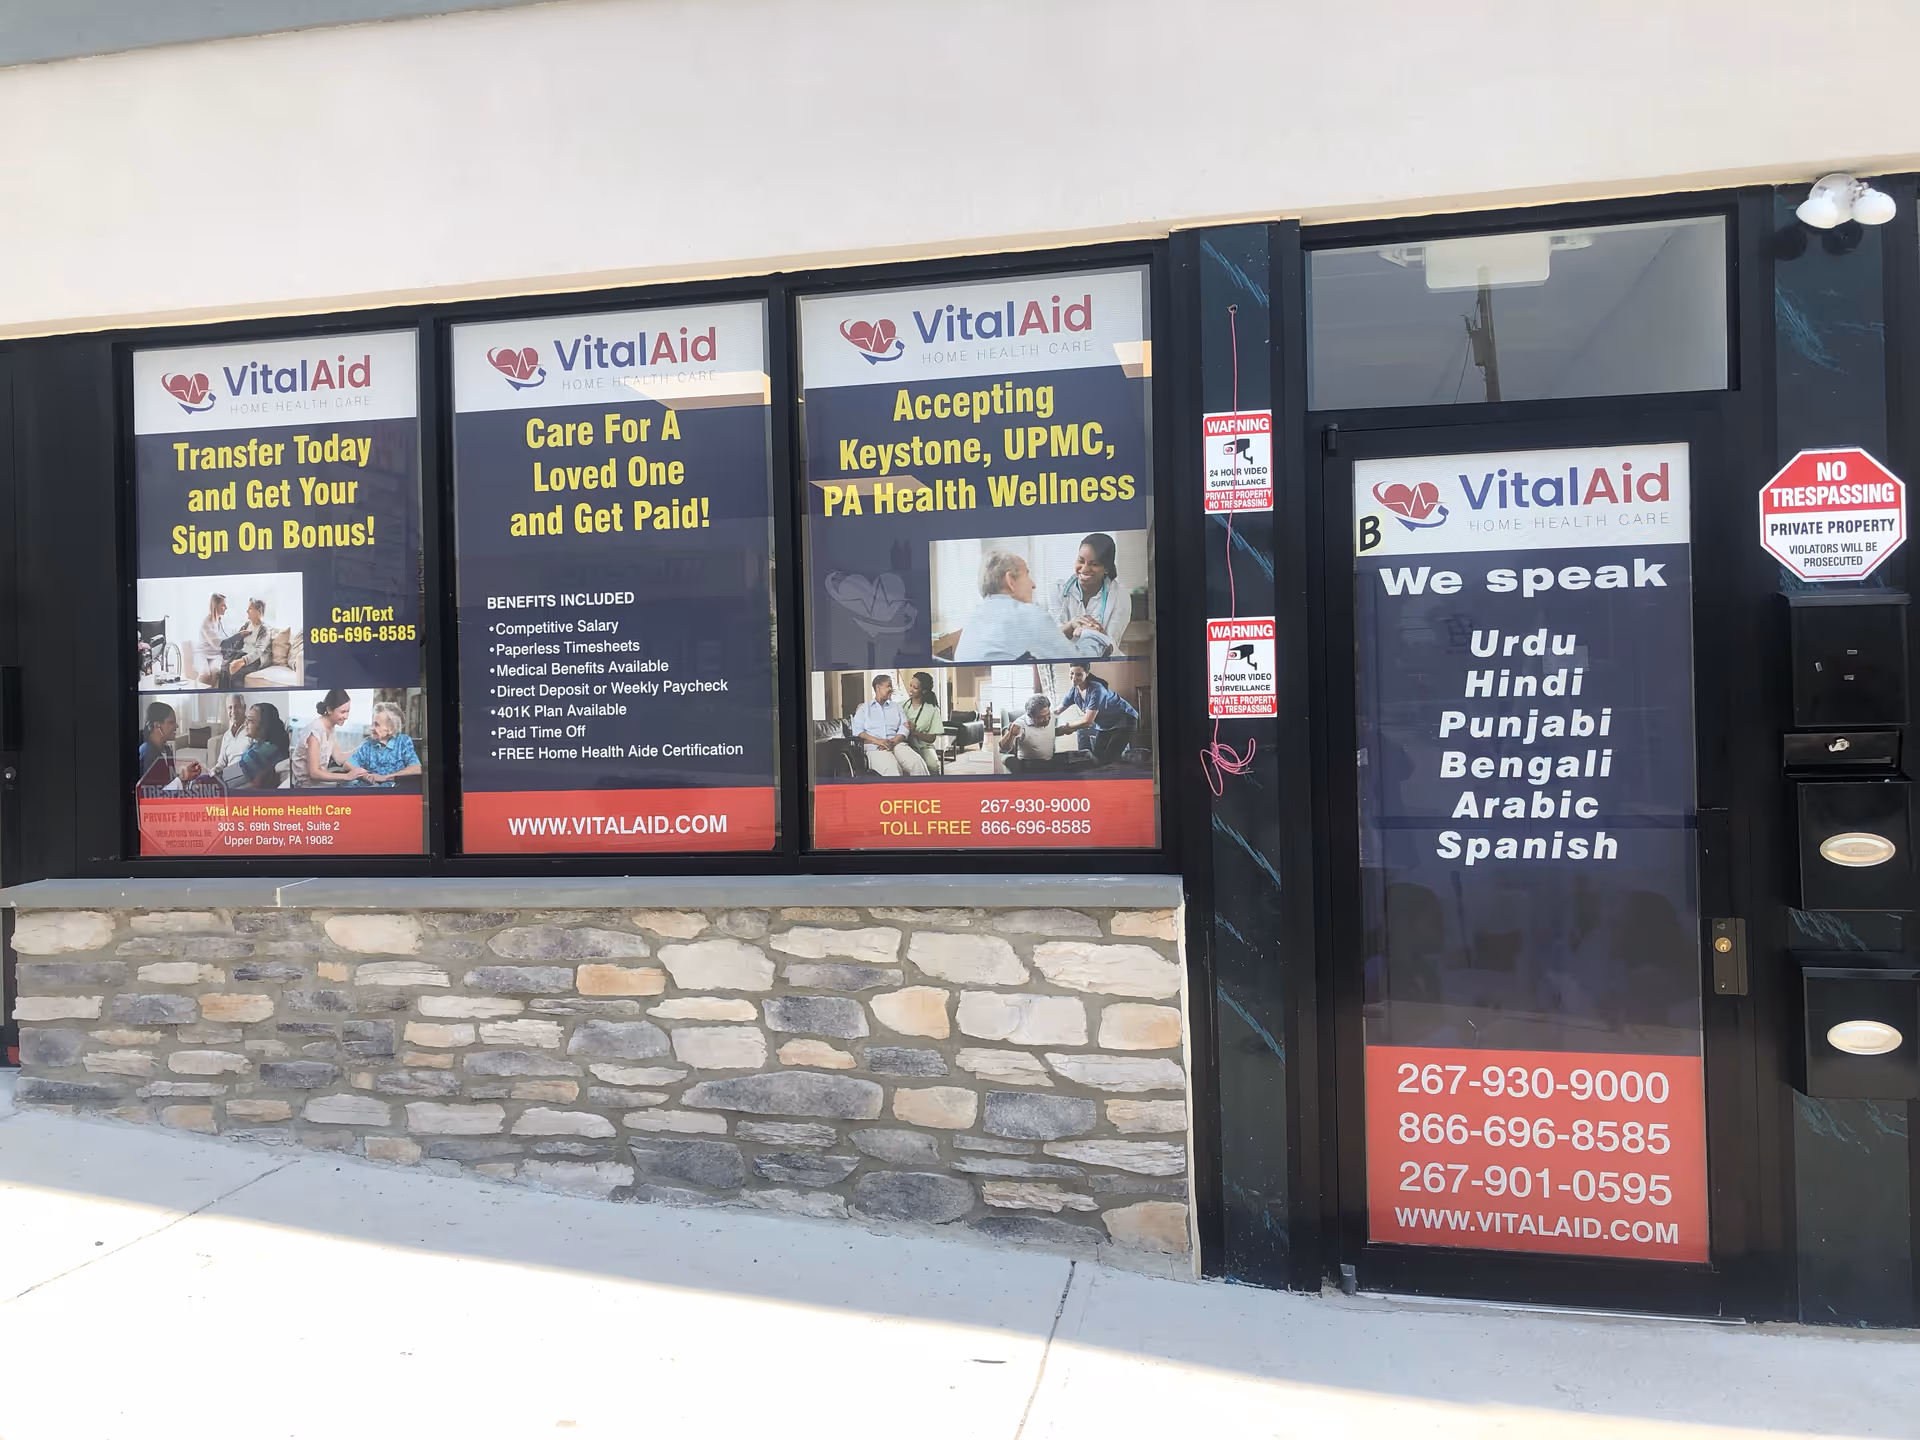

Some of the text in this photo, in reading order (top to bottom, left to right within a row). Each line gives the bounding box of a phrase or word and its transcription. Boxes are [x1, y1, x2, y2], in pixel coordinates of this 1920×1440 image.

[912, 294, 1093, 344] VitalAid
[554, 326, 717, 371] VitalAid
[922, 340, 1093, 364] HOME HEALTH CARE
[223, 354, 371, 397] VitalAid
[563, 370, 716, 390] HOME HEALTH CARE
[230, 396, 371, 415] HOME HEALTH CARE
[893, 381, 1054, 424] Accepting
[526, 410, 681, 449] Care For A
[173, 433, 372, 471] Transfer Today
[839, 421, 1116, 476] Keystone, UPMC,
[534, 455, 684, 492] Loved One
[1243, 466, 1268, 475] VIDEO
[1816, 461, 1847, 482] NO
[188, 476, 358, 512] and Get Your
[823, 472, 1136, 517] PA Health Wellness
[1205, 489, 1272, 501] PRIVATE PROPERTY
[1459, 462, 1670, 511] VitalAid
[1770, 482, 1895, 507] TRESPASSING
[1208, 501, 1219, 509] NO
[510, 497, 710, 536] and Get Paid!
[1470, 511, 1669, 532] HOME HEALTH CARE
[1771, 518, 1895, 536] PRIVATE PROPERTY
[172, 516, 375, 560] Sign On Bonus!
[1359, 515, 1382, 552] B
[1789, 542, 1878, 555] VIOLATORS WILL BE
[1804, 555, 1863, 567] PROSECUTED
[1379, 558, 1667, 597] We speak
[487, 592, 634, 609] BENEFITS INCLUDED
[331, 606, 394, 623] Call/Text
[310, 624, 416, 643] 866-696-8585
[496, 619, 619, 637] Competitive Salary
[1210, 624, 1273, 639] WARNING
[496, 640, 640, 658] Paperless Timesheets
[1470, 628, 1576, 658] Urdu
[497, 659, 669, 676] Medical Benefits Available
[1213, 672, 1272, 682] 24 HOUR VIDEO
[497, 679, 729, 699] Direct Deposit or Weekly Paycheck
[1215, 684, 1271, 692] SURVEILLANCE
[1465, 667, 1584, 698] Hindi
[497, 703, 627, 718] 401K Plan Available
[1209, 695, 1276, 705] PRIVATE PROPERTY
[1213, 704, 1272, 714] NO TRESPASSING
[498, 724, 586, 739] Paid Time Off
[1439, 707, 1612, 744] Punjabi
[498, 742, 744, 760] FREE Home Health Aide Certification
[1440, 748, 1613, 785] Bengali
[206, 804, 352, 817] Vital Aid Home Health Care
[879, 798, 1091, 815] OFFICE 267-930-9000
[1451, 790, 1599, 819] Arabic
[217, 821, 340, 832] 303 S. 69th Street, Suite 2
[507, 814, 728, 836] WWW.VITALAID.COM
[879, 819, 1092, 835] TOLL FREE 866-696-8585
[224, 835, 334, 847] Upper Darby, PA 19082
[1436, 831, 1618, 865] Spanish
[1397, 1062, 1670, 1104] 267-930-9000
[1398, 1112, 1671, 1155] 866-696-8585
[1399, 1161, 1672, 1206] 267-901-0595
[1395, 1207, 1679, 1245] WWW.VITALAID.COM
